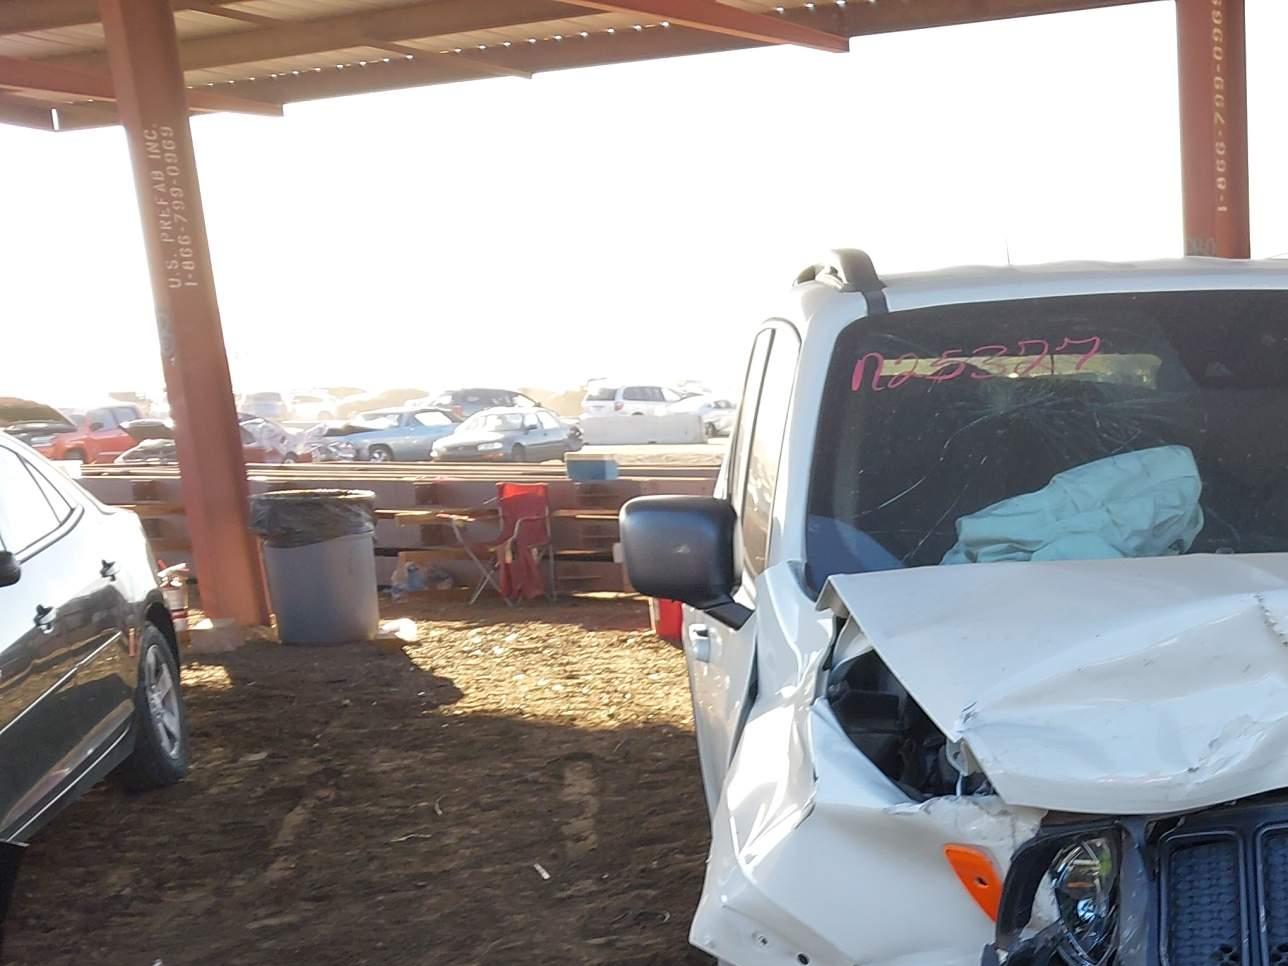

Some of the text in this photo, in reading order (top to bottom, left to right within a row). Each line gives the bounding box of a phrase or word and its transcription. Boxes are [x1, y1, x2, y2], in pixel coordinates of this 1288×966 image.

[143, 123, 182, 289] U.S. PREFAB INC.
[159, 126, 199, 287] 1-866-799-0969
